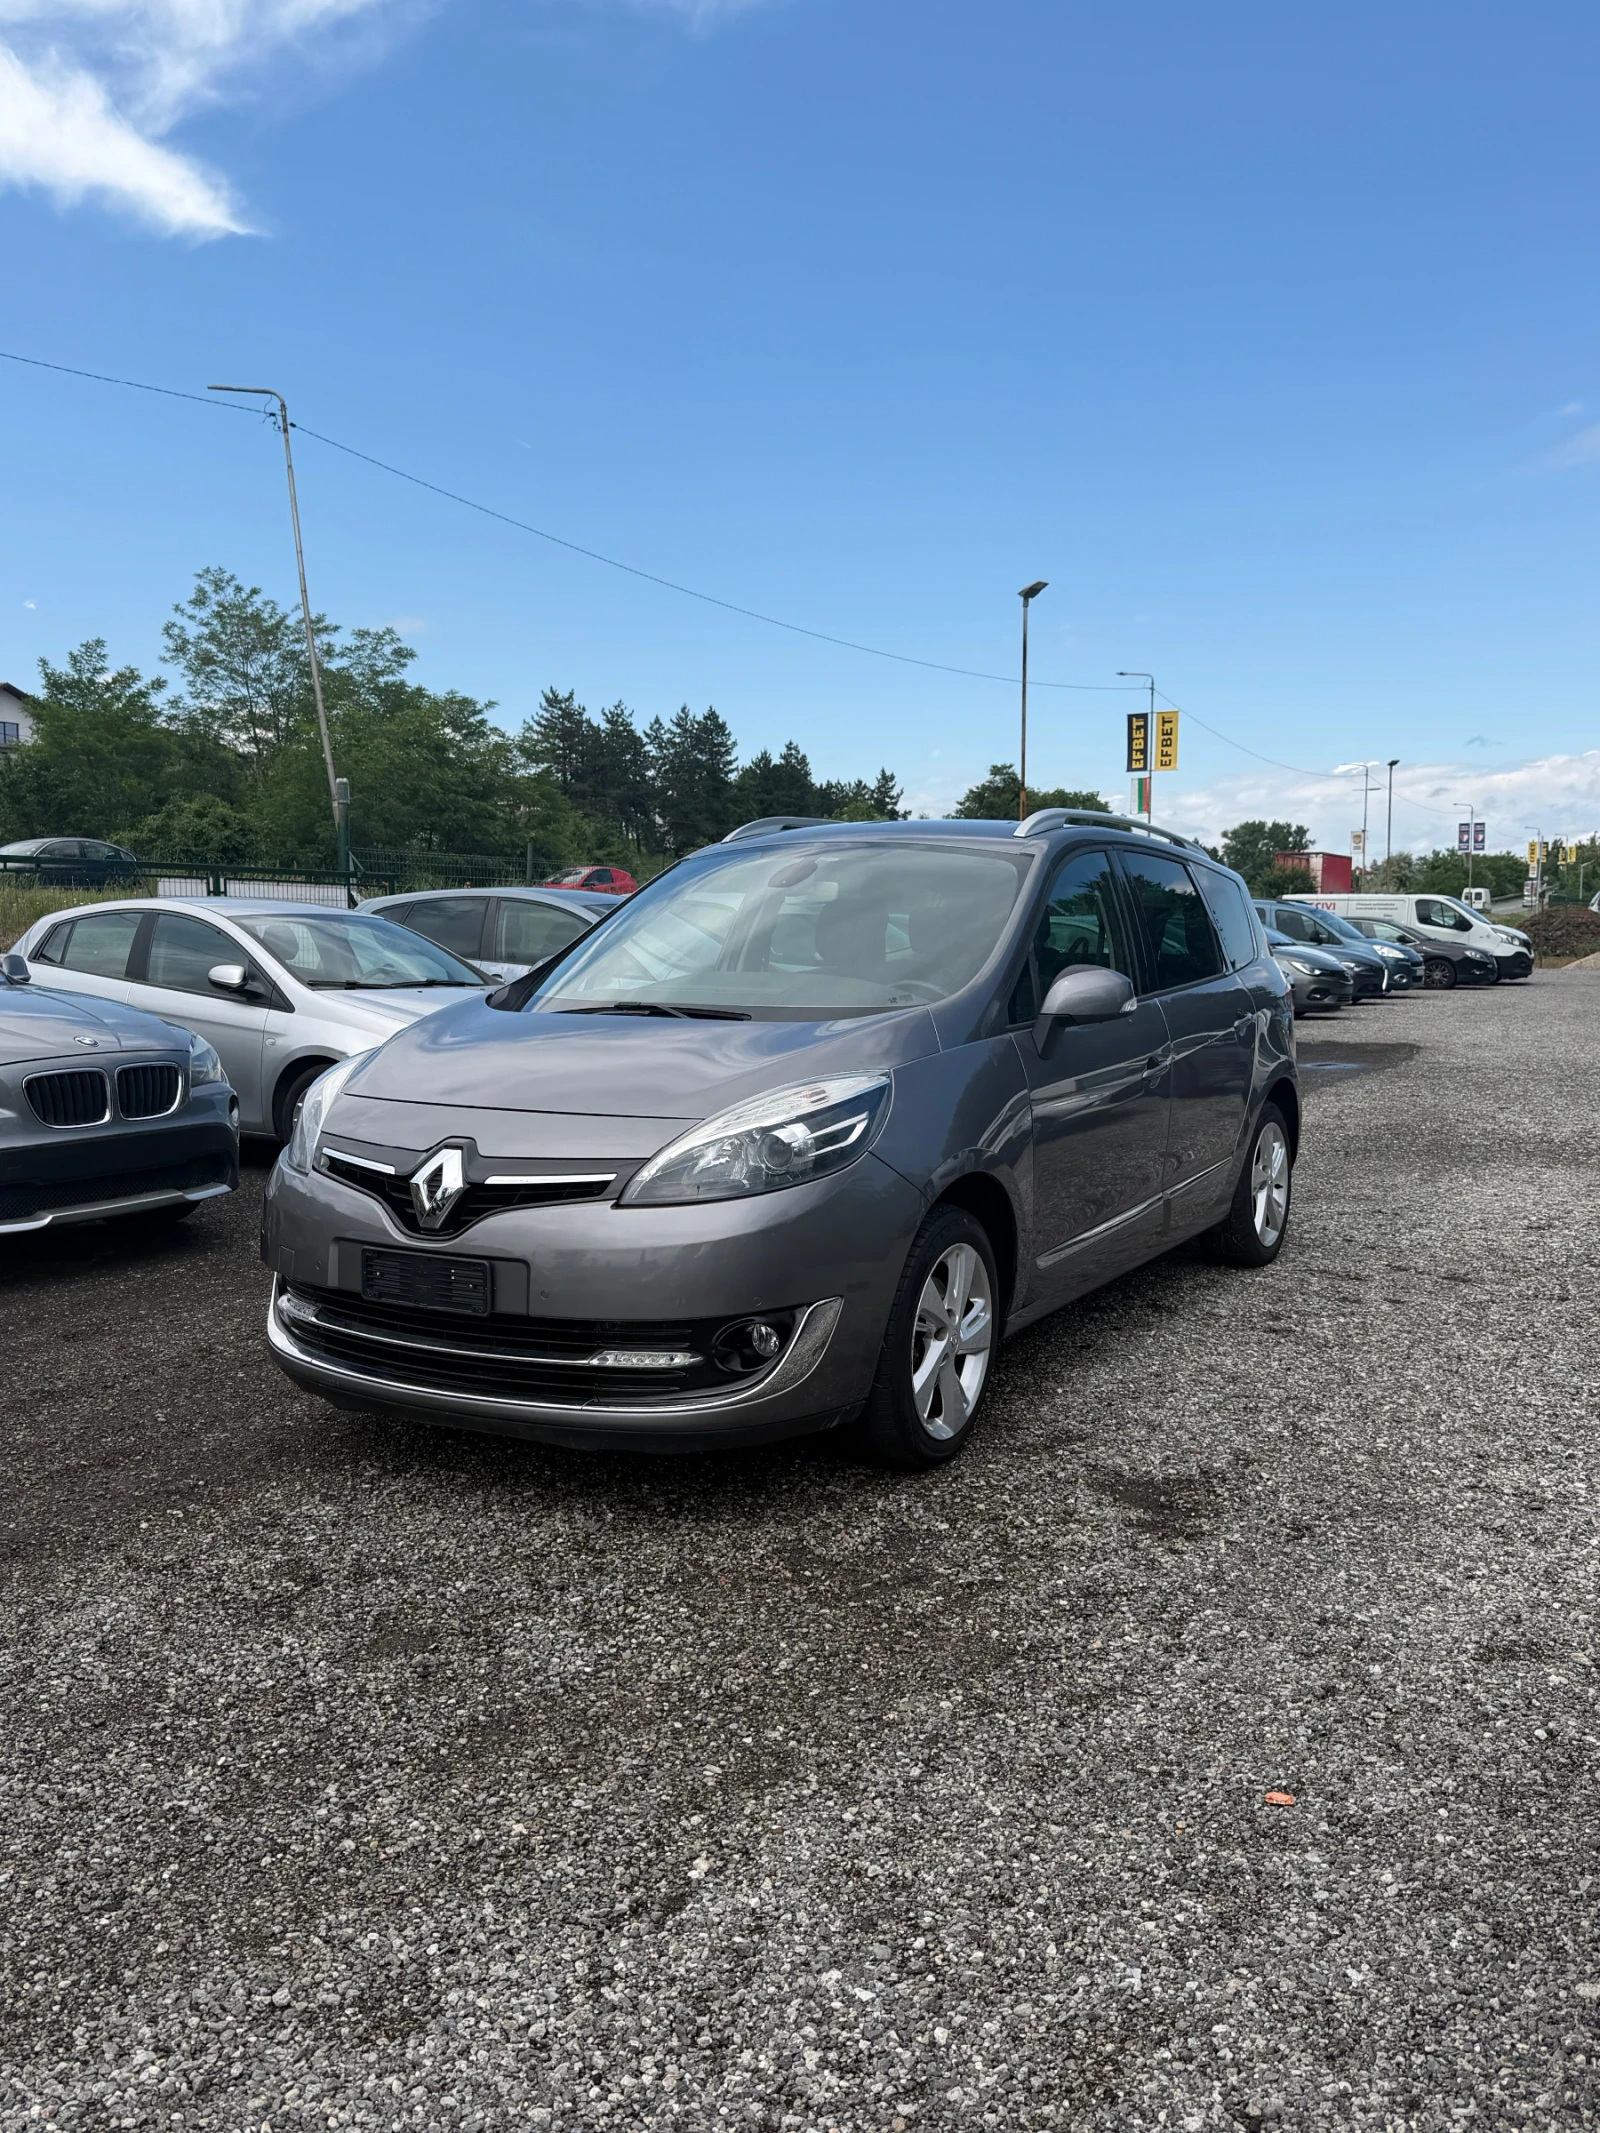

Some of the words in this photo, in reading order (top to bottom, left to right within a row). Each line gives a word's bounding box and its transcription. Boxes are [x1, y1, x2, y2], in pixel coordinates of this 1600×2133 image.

[1132, 717, 1144, 769] EFBET
[1160, 716, 1173, 766] EFBET
[1309, 902, 1336, 911] CIVI
